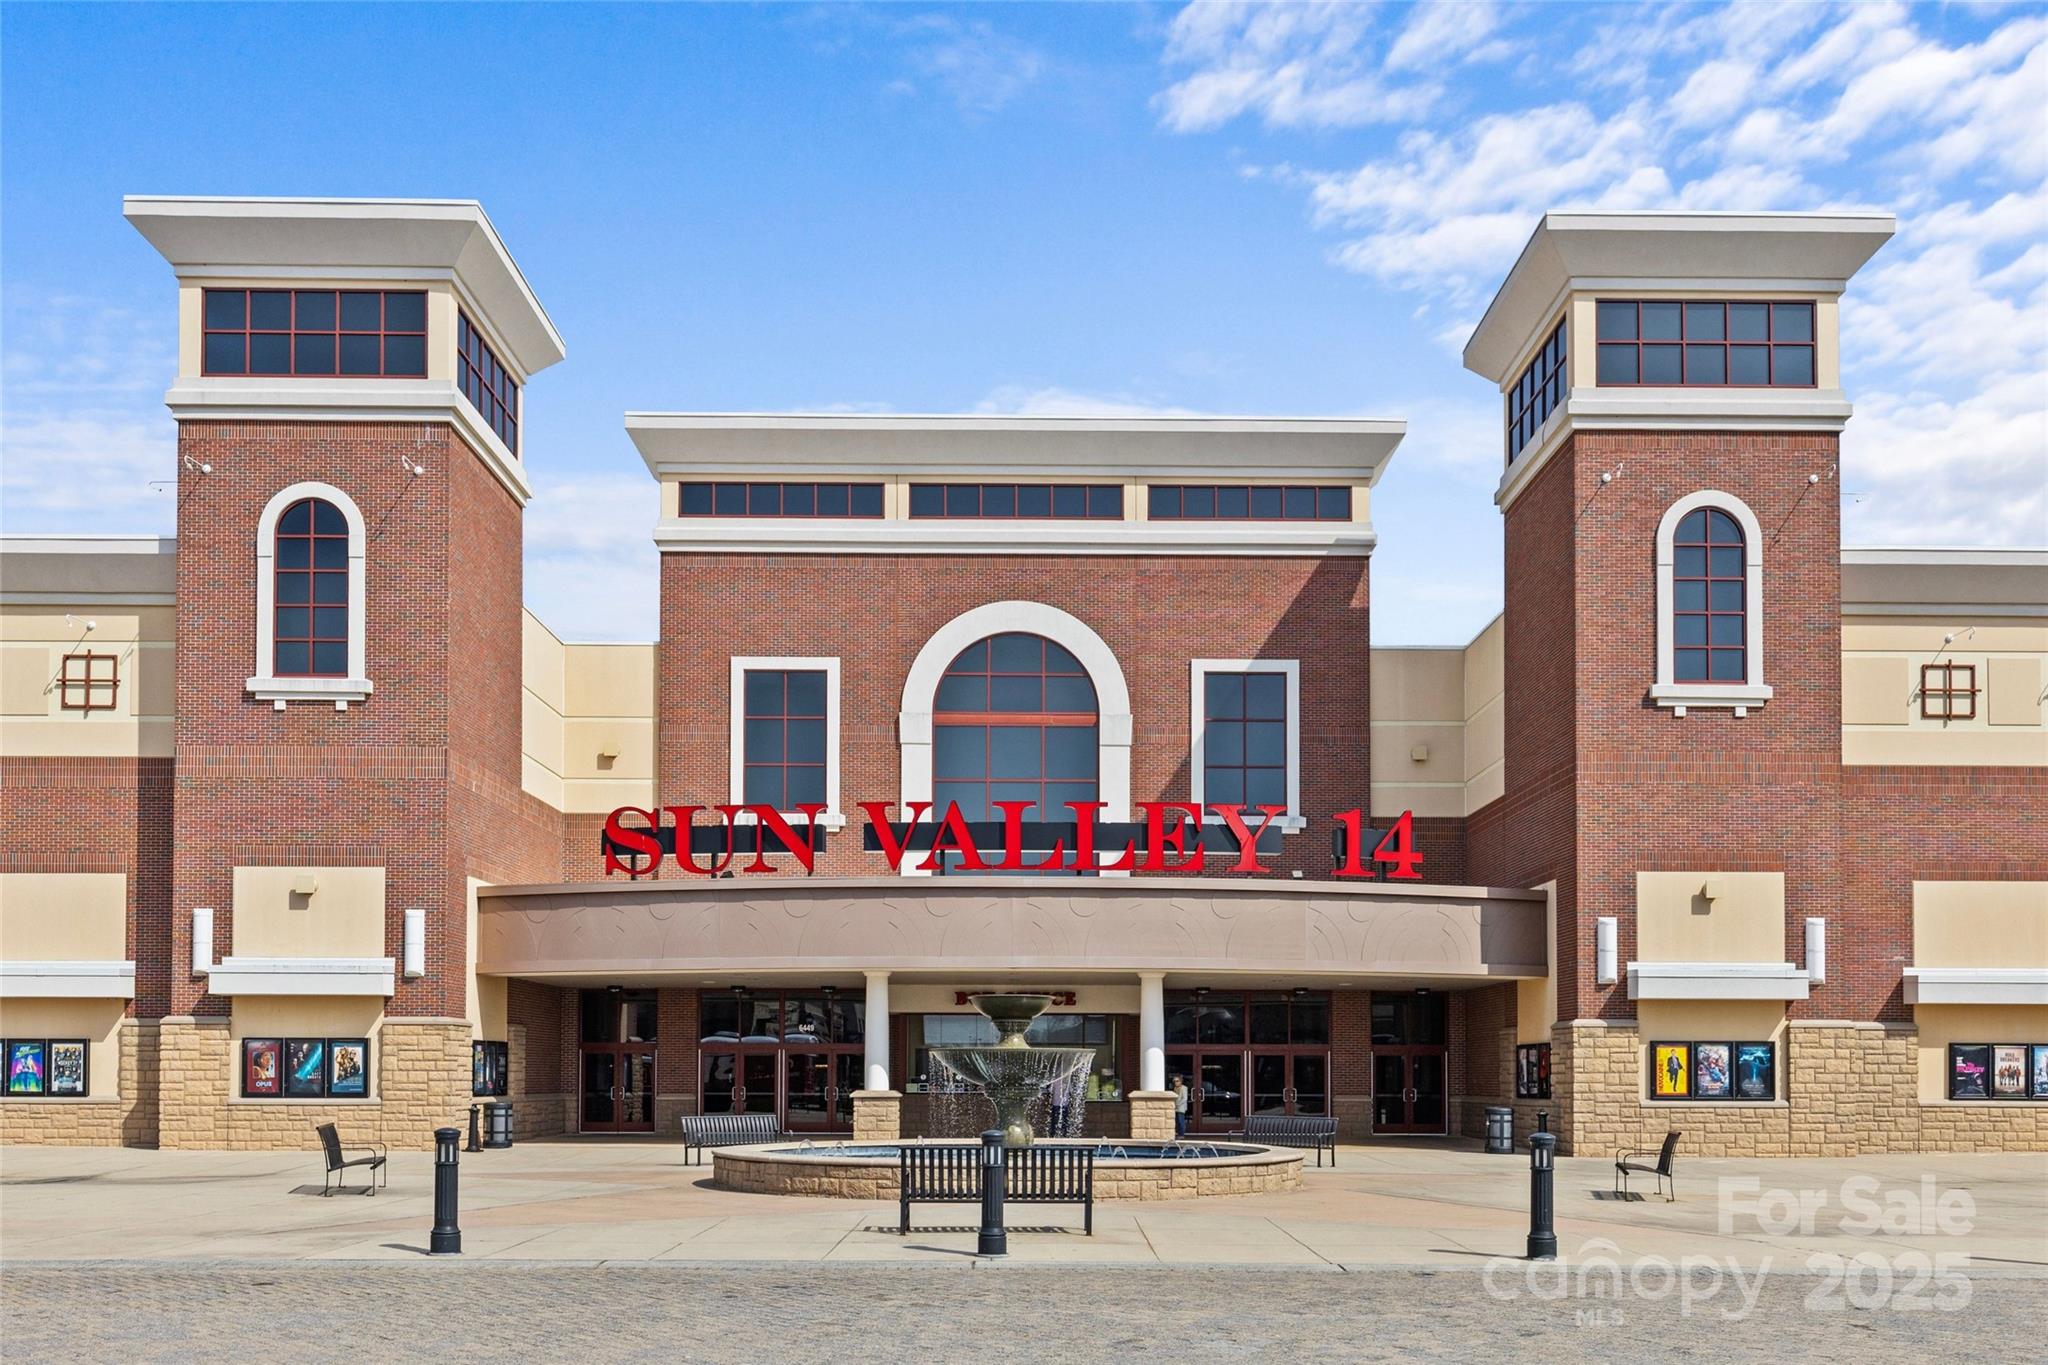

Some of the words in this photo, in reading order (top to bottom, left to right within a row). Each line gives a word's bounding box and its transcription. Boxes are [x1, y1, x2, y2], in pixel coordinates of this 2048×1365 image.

[605, 804, 828, 877] SUN
[857, 800, 1288, 872] VALLEY
[1331, 808, 1423, 879] 14
